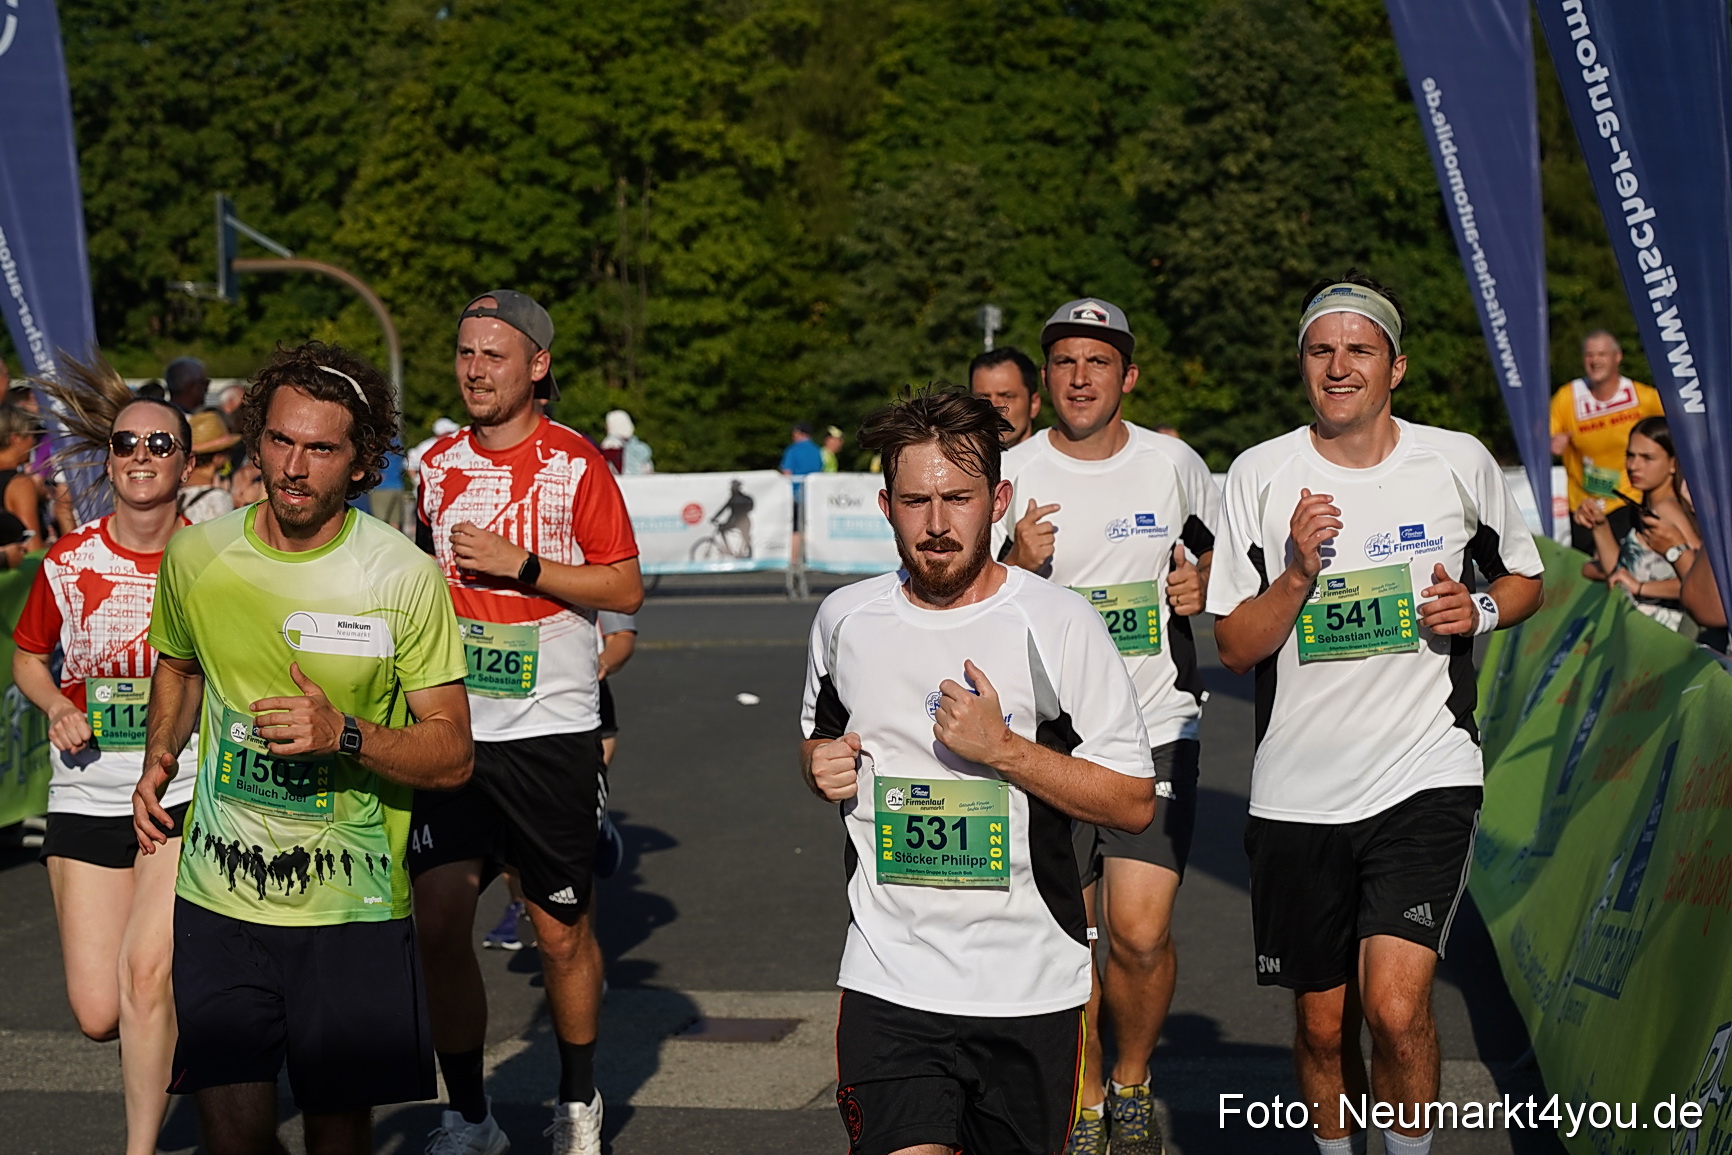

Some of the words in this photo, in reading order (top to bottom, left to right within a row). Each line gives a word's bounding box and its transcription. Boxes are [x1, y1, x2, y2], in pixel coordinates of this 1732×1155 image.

[1130, 525, 1168, 535] Firmenlauf
[1394, 536, 1443, 552] Firmenlauf
[1415, 545, 1443, 555] neumarkt
[1323, 585, 1360, 597] Firmenlauf
[337, 621, 371, 630] Klinikum
[1101, 608, 1138, 634] 28
[1148, 609, 1158, 644] 2022
[1326, 598, 1383, 631] 541
[1398, 598, 1412, 639] 2022
[1302, 615, 1316, 644] RUN
[1317, 631, 1371, 644] Sebastian
[1374, 626, 1399, 638] Wolf
[478, 673, 522, 685] Sebastian
[522, 655, 533, 689] 2022
[93, 711, 102, 736] RUN
[221, 751, 233, 784] RUN
[236, 748, 313, 789] 1507
[237, 779, 278, 799] Bialluch
[281, 791, 307, 803] Joel
[316, 766, 328, 808] 2022
[905, 798, 945, 806] Firmenlauf
[412, 824, 434, 853] 44
[882, 824, 893, 861] RUN
[905, 815, 967, 850] 531
[989, 822, 1003, 871] 2022
[894, 851, 938, 865] Stöcker
[941, 854, 987, 868] Philipp
[1403, 910, 1436, 928] adidas
[1258, 955, 1281, 973] SW
